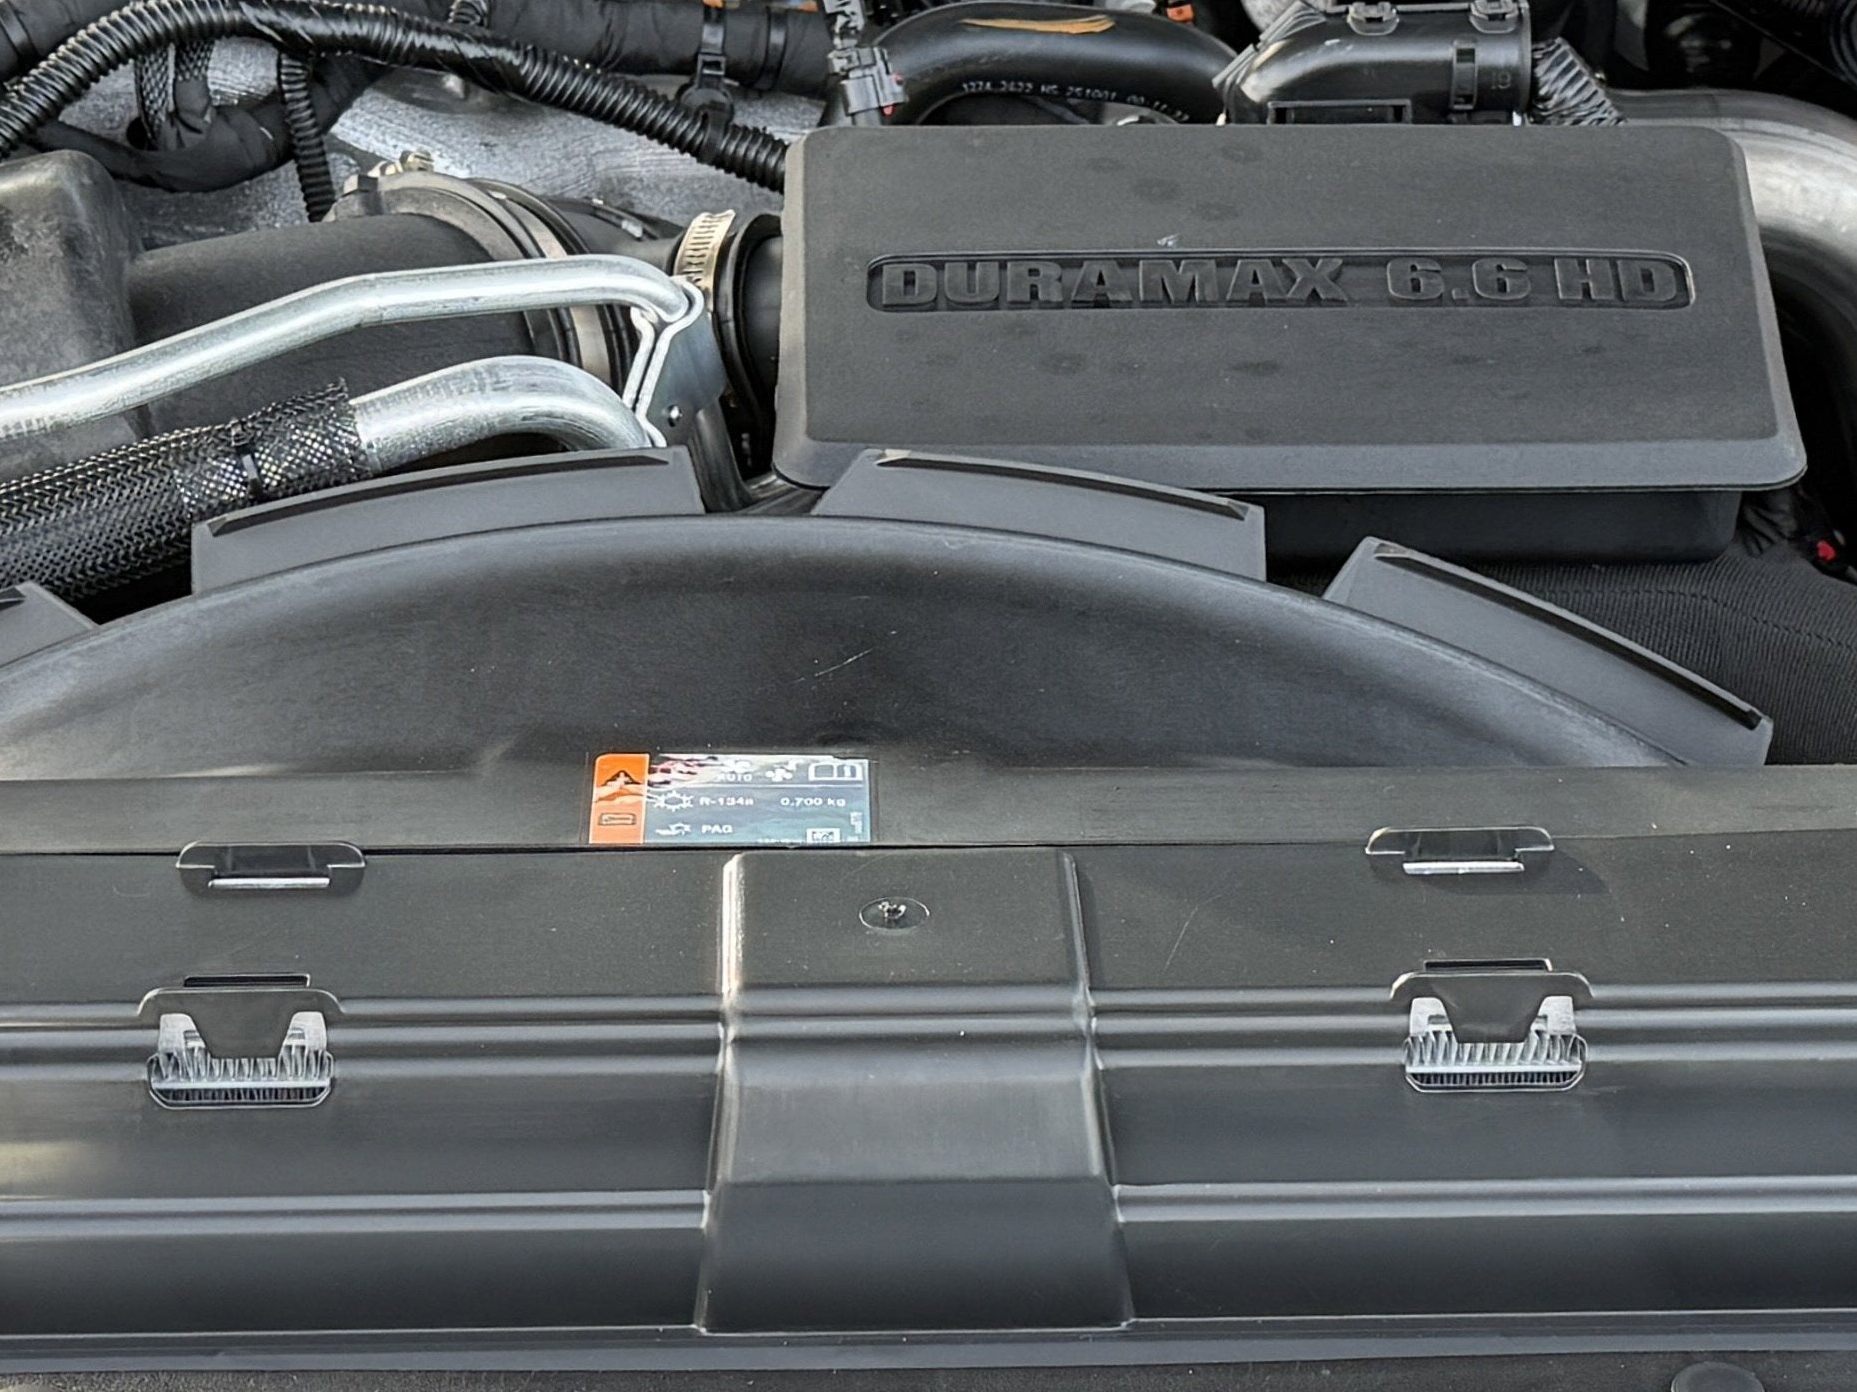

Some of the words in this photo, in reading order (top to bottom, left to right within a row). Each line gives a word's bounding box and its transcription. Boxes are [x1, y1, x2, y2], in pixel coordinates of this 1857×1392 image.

[880, 257, 1346, 305] DURAMAX
[1384, 255, 1533, 302] 6.6
[1552, 256, 1680, 304] HD
[827, 797, 846, 808] kg
[701, 823, 734, 834] PAG
